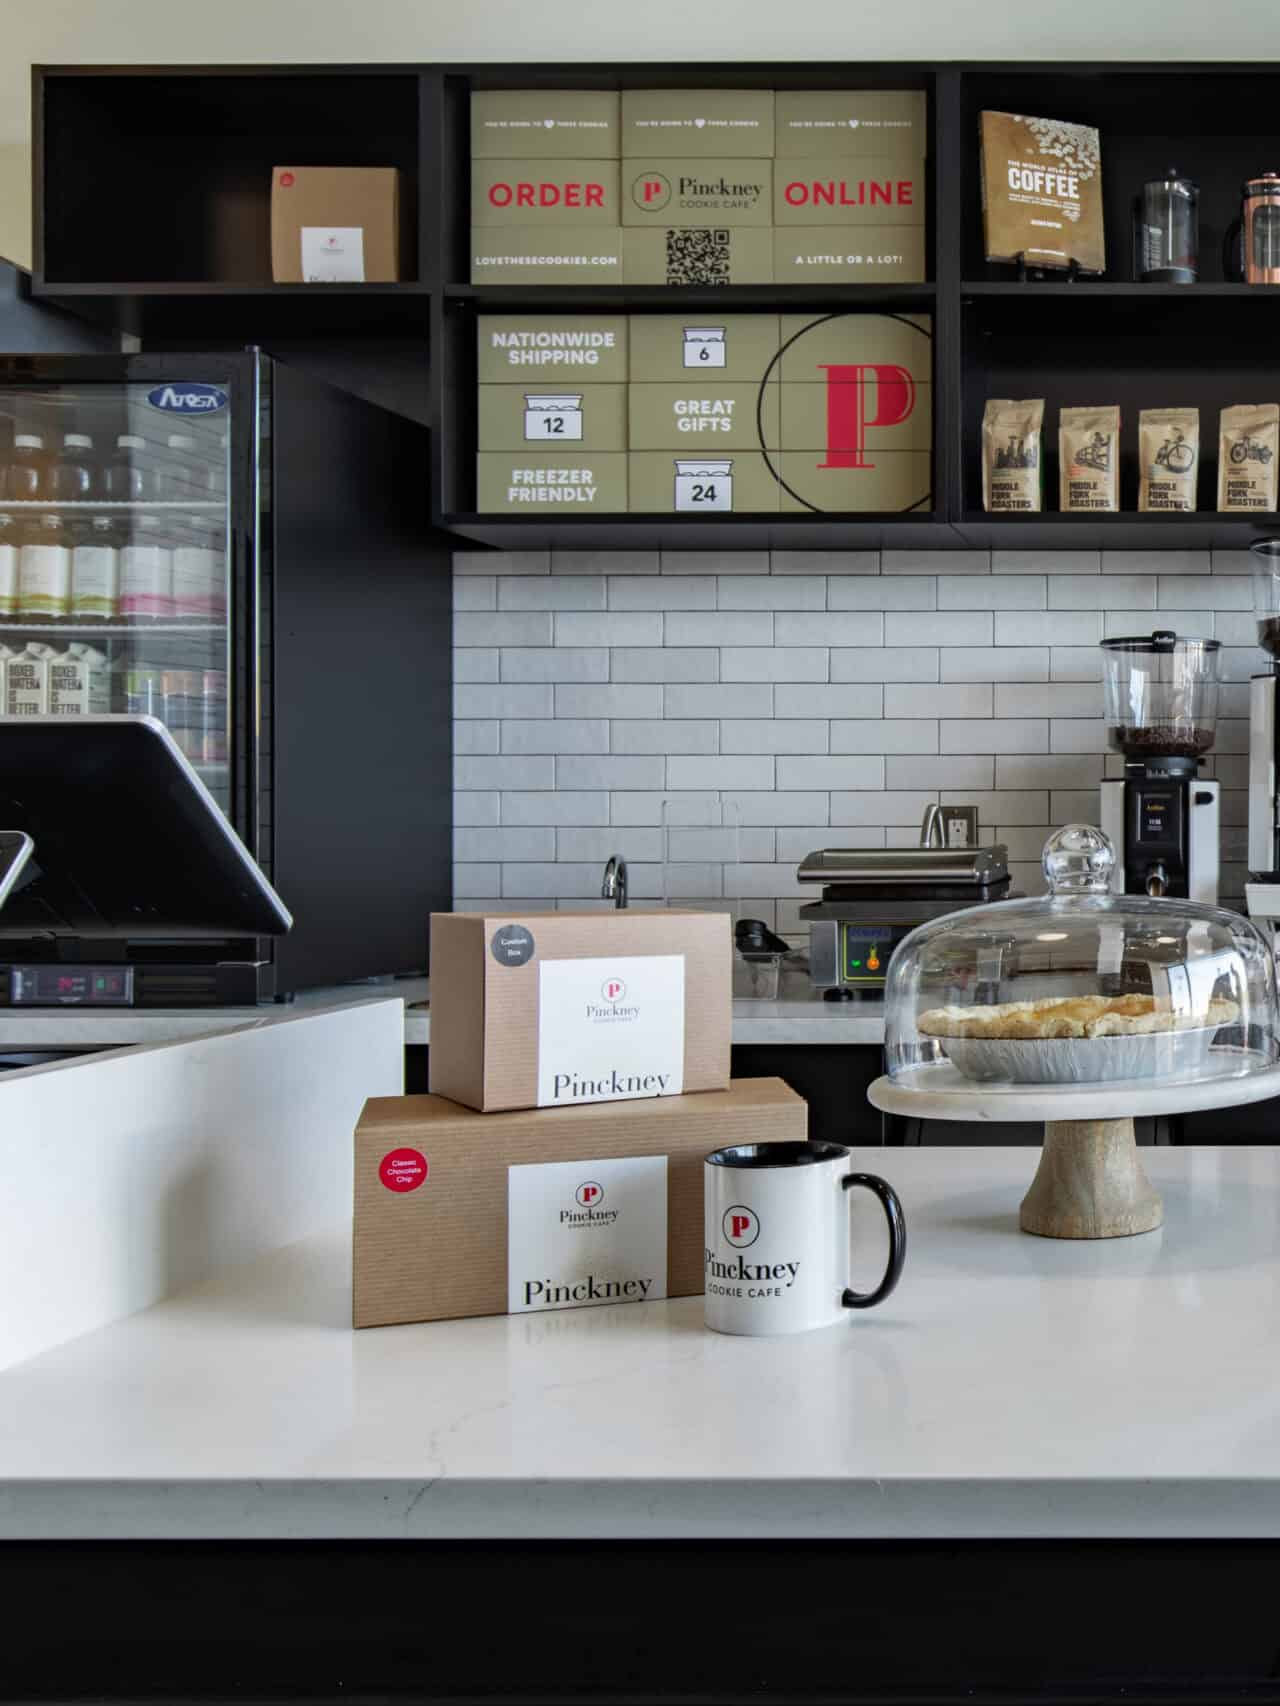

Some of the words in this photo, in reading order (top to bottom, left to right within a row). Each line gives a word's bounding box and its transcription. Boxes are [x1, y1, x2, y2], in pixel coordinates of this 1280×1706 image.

[679, 177, 764, 202] Pinckney
[1008, 168, 1080, 199] COFFEE
[488, 183, 605, 207] ORDER
[784, 182, 913, 206] ONLINE
[680, 200, 719, 209] COOKIE
[723, 200, 750, 209] CAFE
[476, 256, 617, 265] LOVETHESECOOKIES.COM
[795, 255, 803, 264] A
[807, 255, 843, 264] LITTLE
[847, 255, 862, 264] OR
[866, 255, 874, 264] A
[878, 255, 903, 264] LOT!
[492, 333, 616, 348] NATIONWIDE
[508, 350, 600, 365] SHIPPING
[698, 347, 710, 361] 6
[673, 400, 735, 415] GREAT
[816, 364, 916, 469] P
[543, 417, 565, 434] 12
[677, 417, 732, 432] GIFTS
[512, 470, 593, 484] FREEZER
[508, 487, 597, 502] FRIENDLY
[691, 484, 717, 502] 24
[586, 1003, 641, 1017] Pinckney
[553, 1070, 671, 1099] Pinckney
[391, 1159, 417, 1167] Classic
[387, 1167, 422, 1176] Chocolate
[396, 1176, 413, 1184] Chip
[583, 1187, 598, 1202] P
[560, 1208, 619, 1223] Pinckney
[731, 1215, 750, 1238] P
[705, 1248, 800, 1287] Pinckney
[523, 1275, 653, 1305] Pinckney
[708, 1283, 743, 1298] COOKIE
[749, 1287, 782, 1298] CAFE
